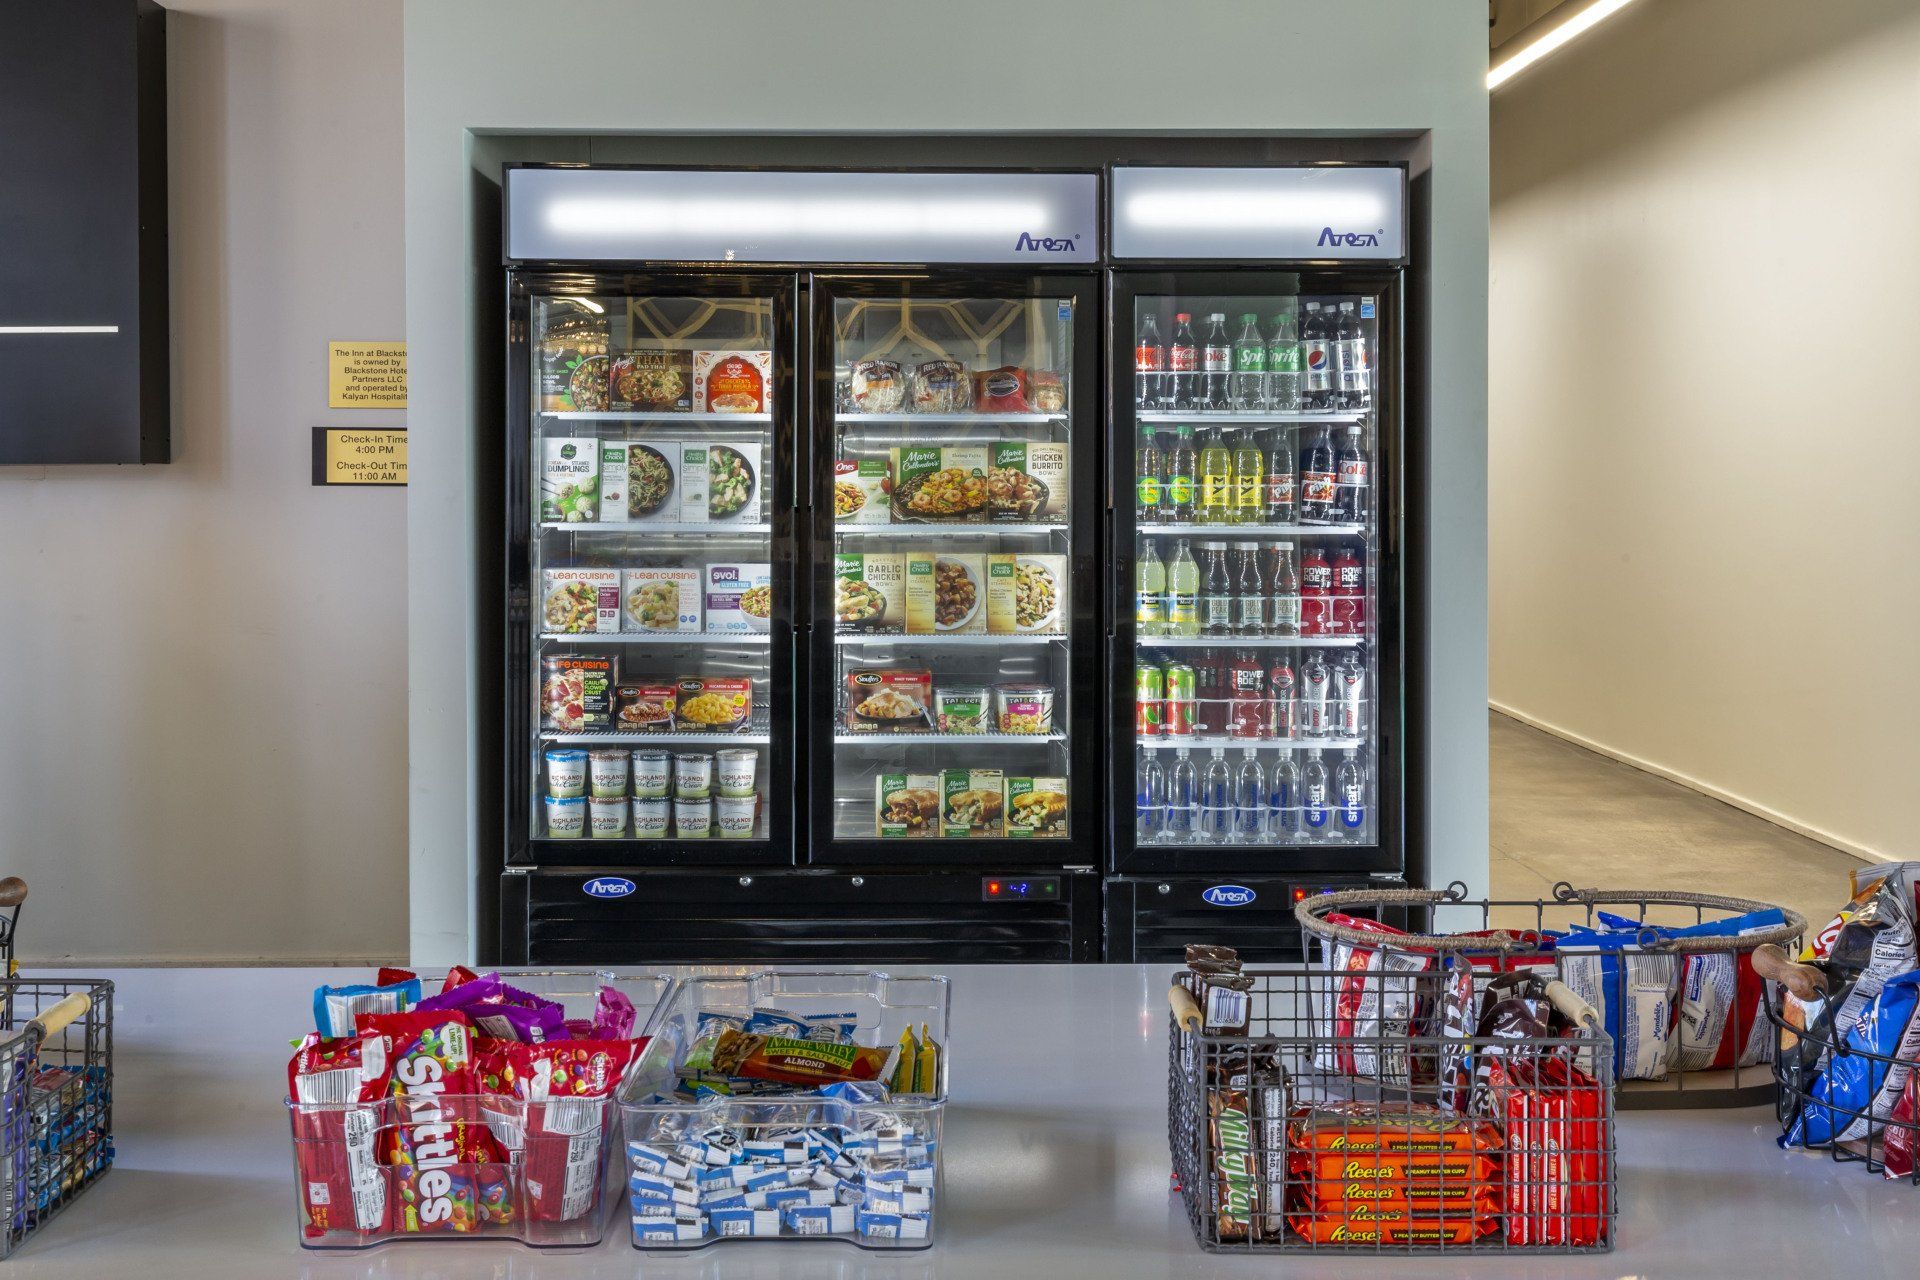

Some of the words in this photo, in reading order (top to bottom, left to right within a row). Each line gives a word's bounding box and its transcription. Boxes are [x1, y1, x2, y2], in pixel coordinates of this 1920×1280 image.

[635, 356, 666, 364] THAI
[924, 363, 936, 372] RED
[362, 385, 397, 393] operated
[400, 385, 407, 393] by
[341, 435, 383, 444] Check-In
[386, 435, 407, 444] Time
[906, 452, 936, 462] Marie
[1000, 450, 1023, 458] Marie
[1304, 566, 1330, 575] POWER
[1310, 784, 1320, 821] smart
[1347, 784, 1357, 822] smart
[1875, 949, 1906, 958] Calories
[449, 1028, 458, 1055] LIME-UP!
[770, 1037, 813, 1048] NATURE
[816, 1042, 853, 1059] VALLEY
[784, 1057, 825, 1068] ALMOND
[834, 1059, 851, 1068] NUT
[348, 1132, 357, 1147] 250
[397, 1056, 459, 1223] Skittles
[1217, 1108, 1250, 1176] Milky
[1328, 1137, 1382, 1152] Reese's
[570, 1151, 579, 1163] 250
[1342, 1161, 1395, 1178] Reese's
[1342, 1183, 1395, 1198] Reese's
[1222, 1173, 1257, 1224] Way
